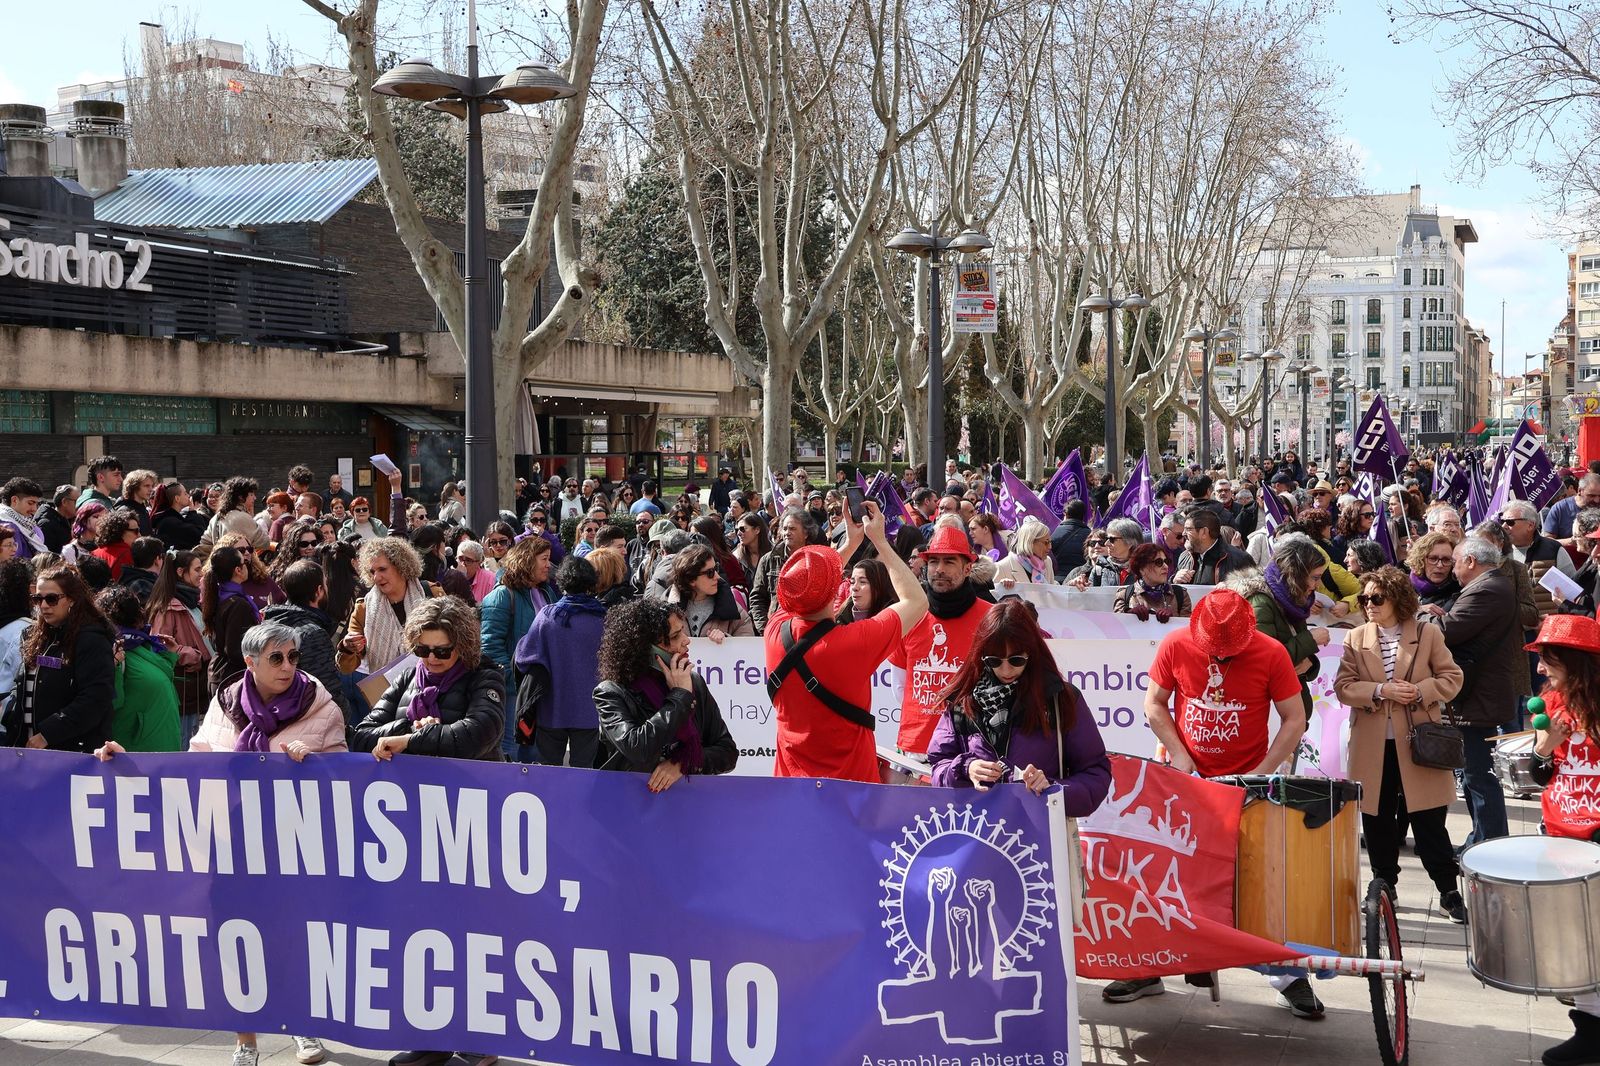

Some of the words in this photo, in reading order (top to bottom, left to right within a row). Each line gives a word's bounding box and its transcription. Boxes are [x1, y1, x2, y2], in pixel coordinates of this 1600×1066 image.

[232, 402, 325, 418] RESTAURANTE
[729, 700, 774, 725] hay
[1185, 704, 1240, 727] BATUKA
[1184, 720, 1239, 742] MATRAKA
[70, 774, 581, 912] FEMINISMO,
[44, 907, 268, 1013] GRITO
[306, 921, 779, 1066] NECESARIO
[861, 1054, 961, 1066] Asamblea
[971, 1052, 1045, 1066] abierta
